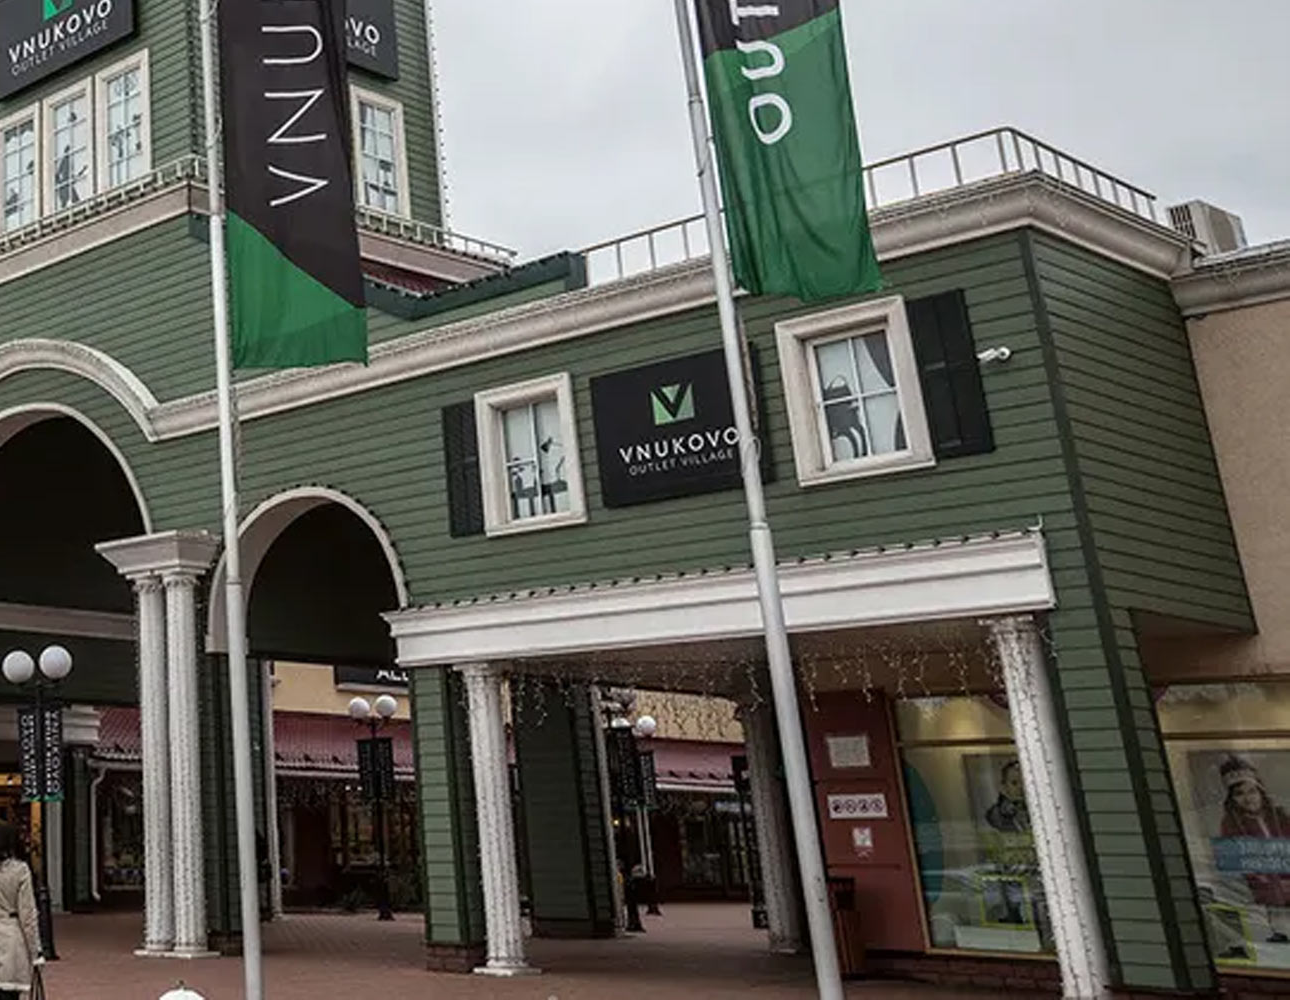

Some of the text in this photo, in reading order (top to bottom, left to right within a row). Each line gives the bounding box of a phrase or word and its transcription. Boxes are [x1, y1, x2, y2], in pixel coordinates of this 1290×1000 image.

[9, 0, 112, 63] VNUKOVO
[11, 19, 108, 76] OUTLET VILLAGE
[345, 17, 380, 44] VO
[729, 0, 792, 144] OUT
[261, 25, 329, 206] VNU
[618, 426, 739, 464] VNUKOVO
[629, 448, 733, 476] OUTLET VILLAGE
